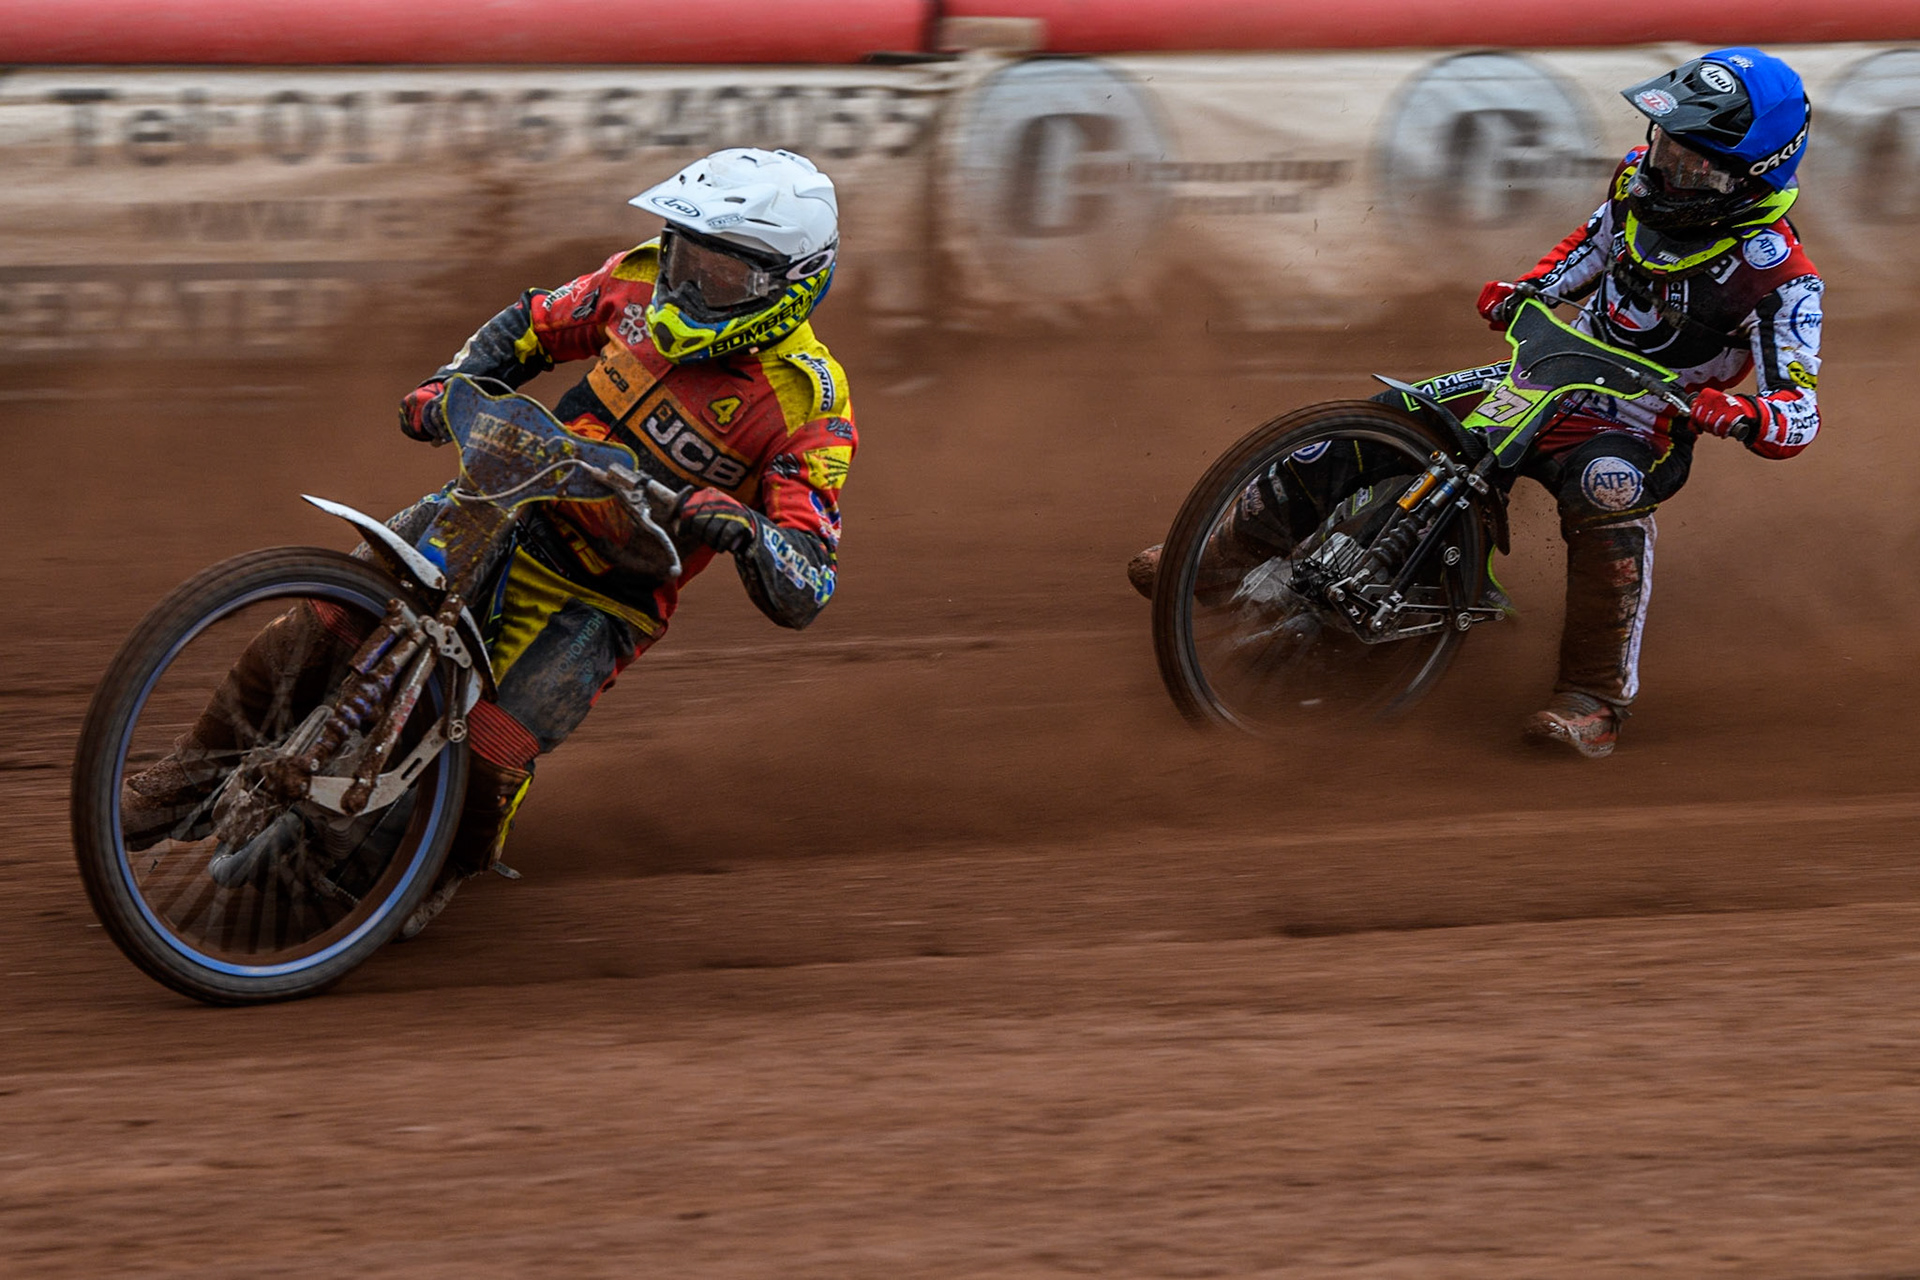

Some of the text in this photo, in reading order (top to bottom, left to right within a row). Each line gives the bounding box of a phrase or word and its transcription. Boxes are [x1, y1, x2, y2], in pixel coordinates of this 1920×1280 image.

[603, 366, 630, 393] JCB
[709, 395, 742, 425] 4
[646, 416, 747, 487] JCB
[1593, 471, 1635, 490] ATPI
